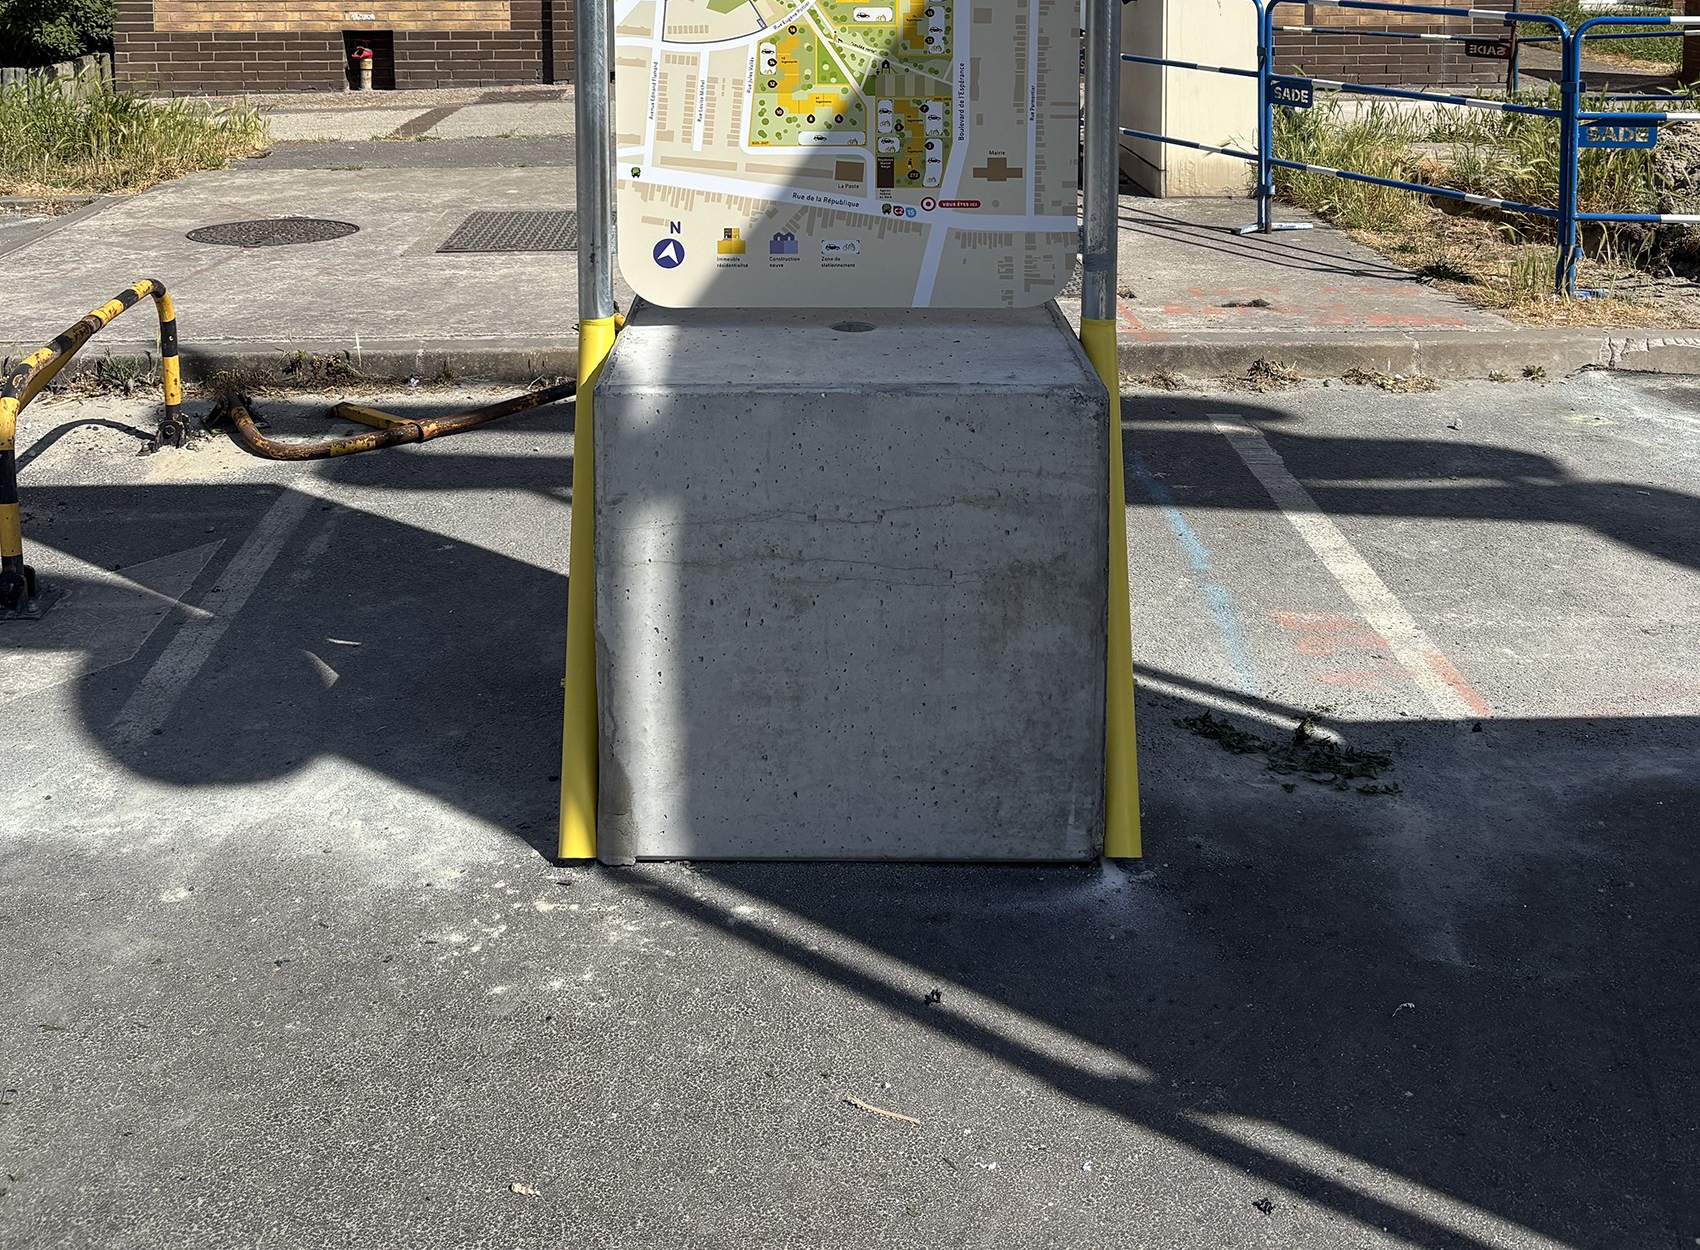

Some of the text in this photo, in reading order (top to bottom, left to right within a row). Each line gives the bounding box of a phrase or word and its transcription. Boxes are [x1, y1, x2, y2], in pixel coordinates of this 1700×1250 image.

[958, 62, 966, 99] l'Espérance
[1274, 86, 1309, 103] SADE
[959, 100, 965, 108] de
[1587, 126, 1649, 142] SADE
[792, 192, 805, 200] Rue
[823, 196, 860, 208] République
[670, 221, 681, 234] N
